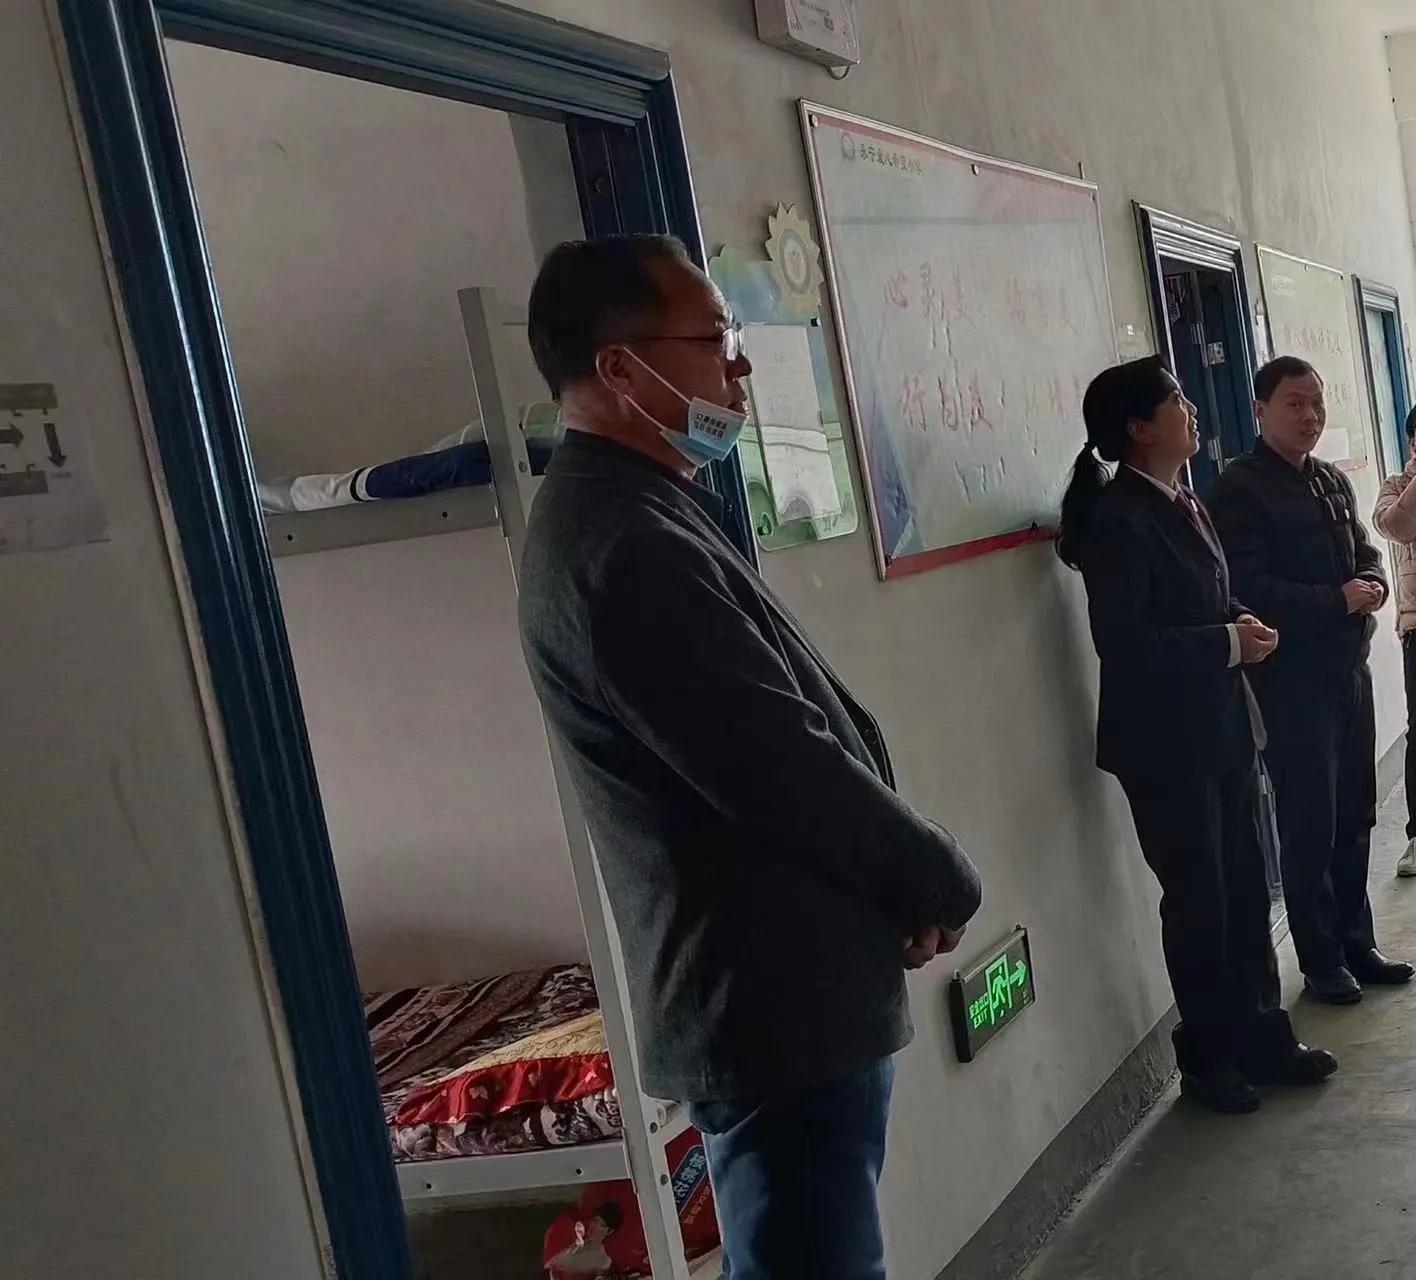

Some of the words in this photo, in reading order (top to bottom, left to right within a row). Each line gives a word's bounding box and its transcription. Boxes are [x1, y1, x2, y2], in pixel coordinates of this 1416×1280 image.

[972, 1008, 989, 1029] EXIT
[673, 1152, 706, 1203] 核桃花
